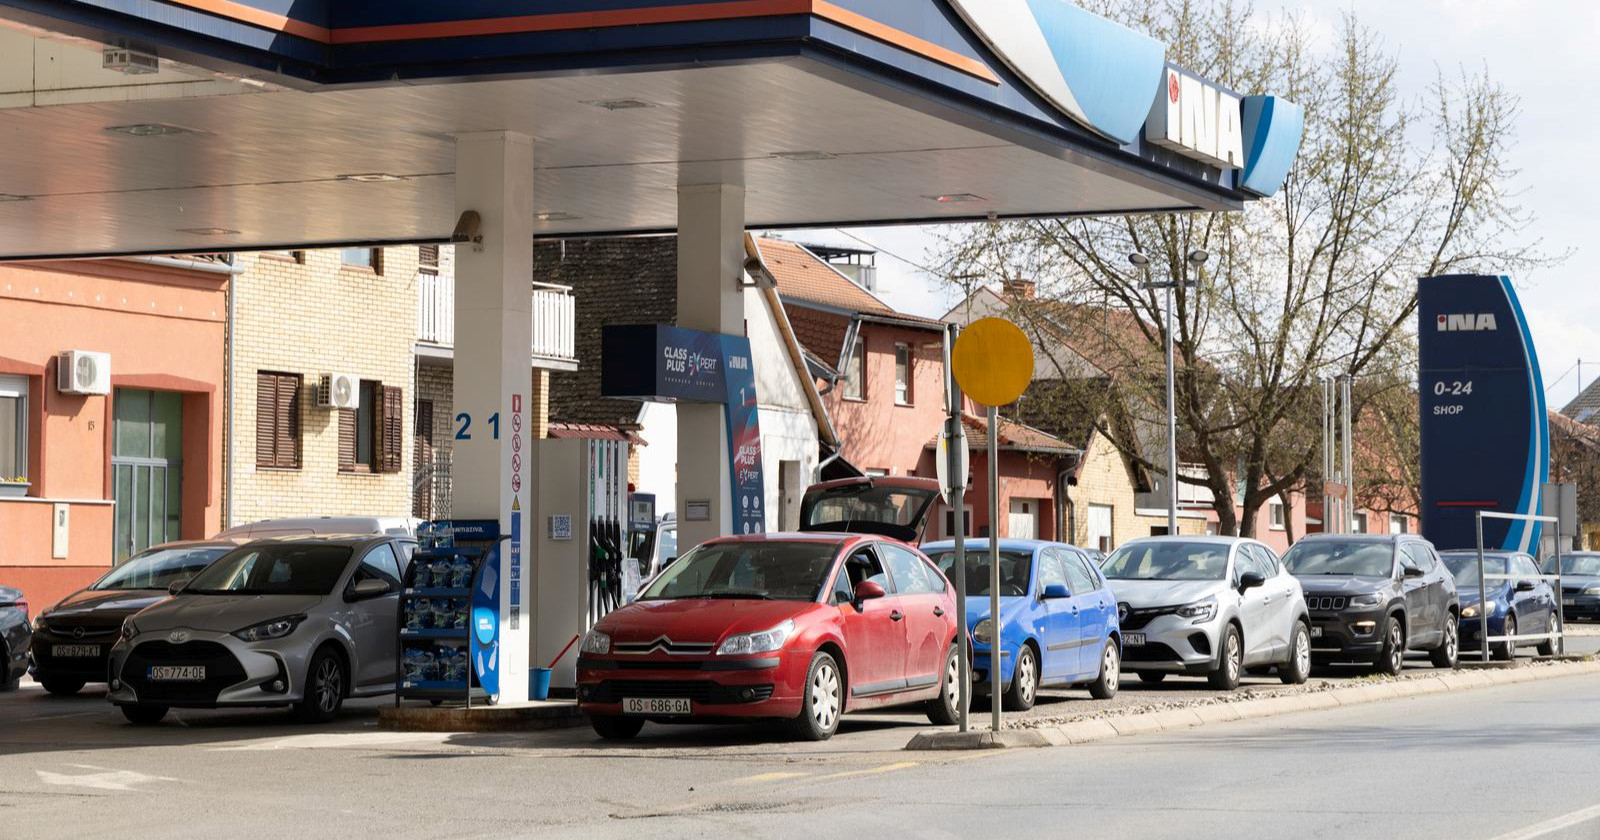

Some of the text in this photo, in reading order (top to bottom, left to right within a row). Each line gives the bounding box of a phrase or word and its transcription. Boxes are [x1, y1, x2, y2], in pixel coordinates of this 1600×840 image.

[664, 346, 687, 360] CLASS
[666, 359, 685, 373] PLUS
[1434, 381, 1473, 395] 0-24
[740, 387, 745, 406] 1
[1433, 405, 1463, 415] SHOP
[455, 412, 499, 440] 2 1
[739, 445, 757, 456] CLASS
[741, 455, 755, 465] PLUS
[153, 667, 164, 678] OS
[629, 698, 689, 712] OS 686-GA
